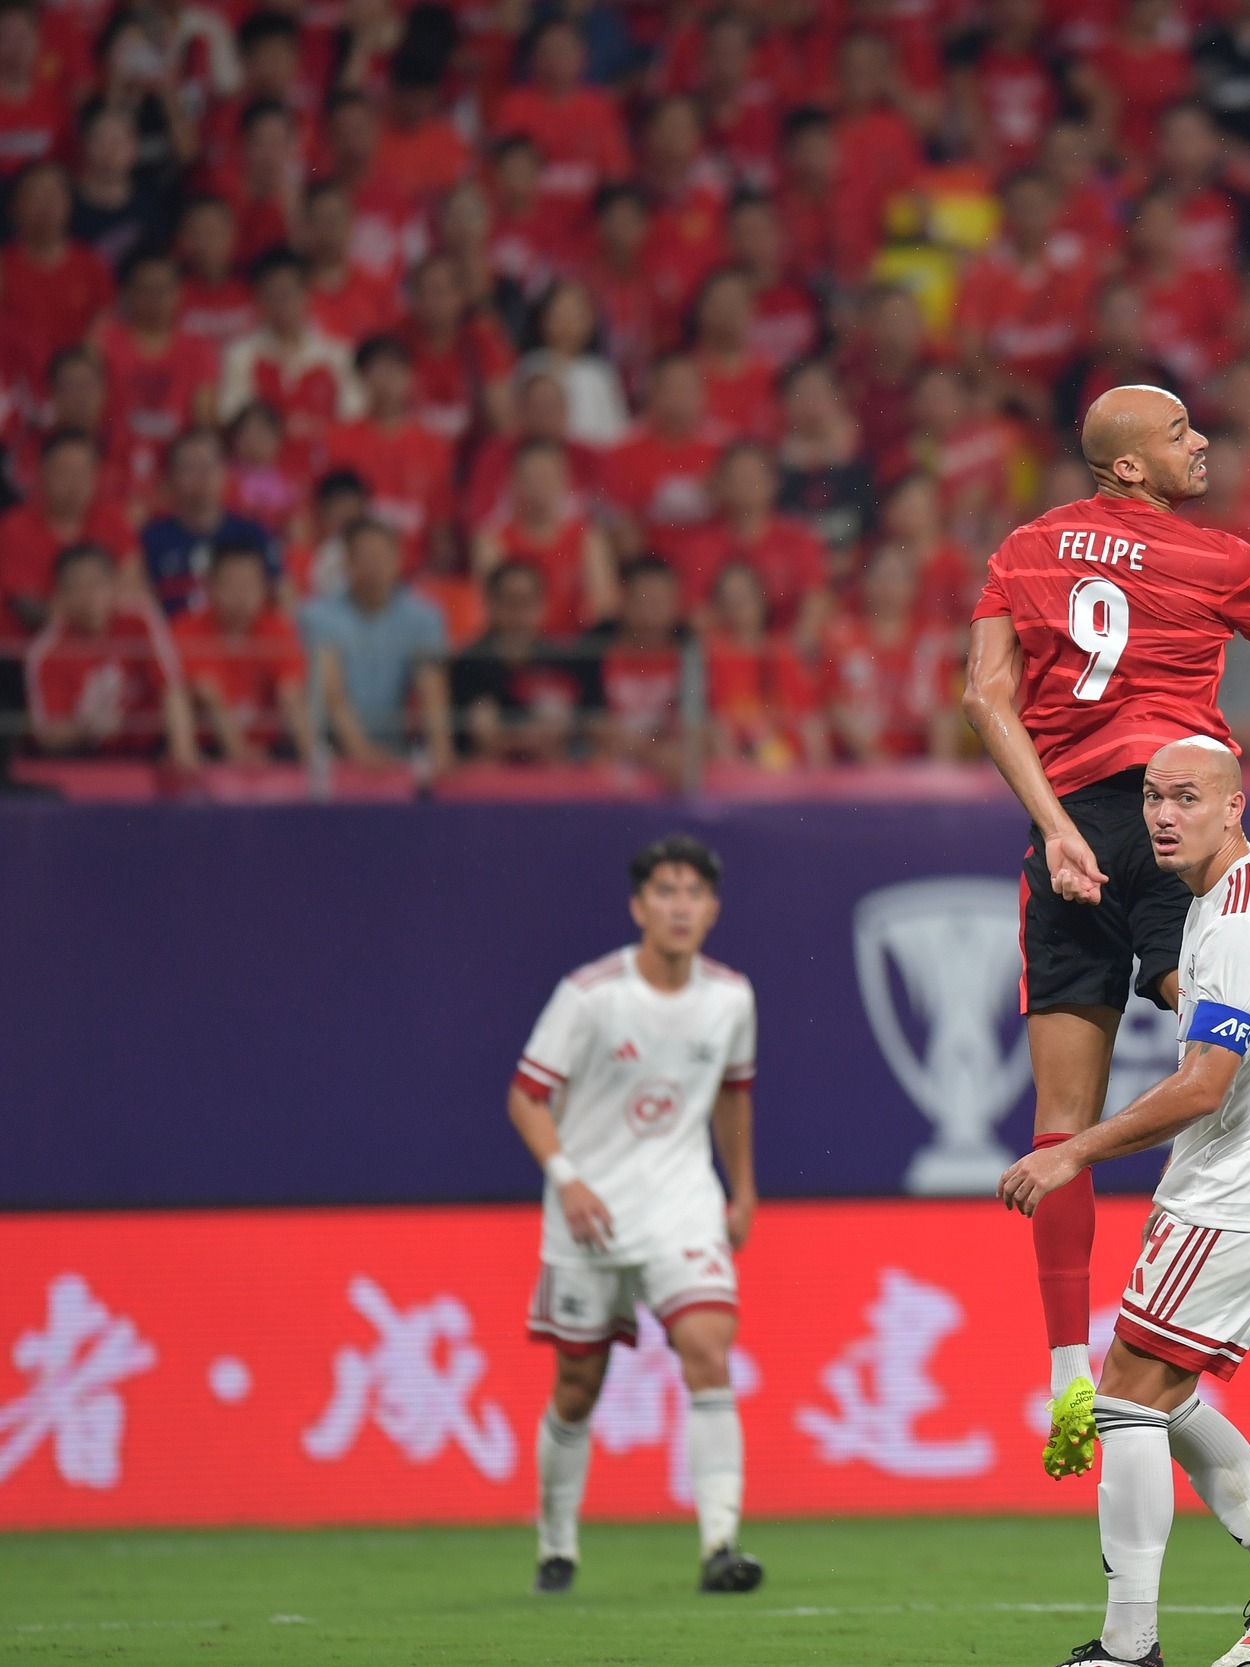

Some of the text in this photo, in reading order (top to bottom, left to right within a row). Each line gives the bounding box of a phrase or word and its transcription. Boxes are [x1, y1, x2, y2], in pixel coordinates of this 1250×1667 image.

[1058, 531, 1147, 571] FELIPE
[1069, 576, 1129, 701] 9
[1069, 1395, 1093, 1408] balan
[1075, 1390, 1093, 1398] new
